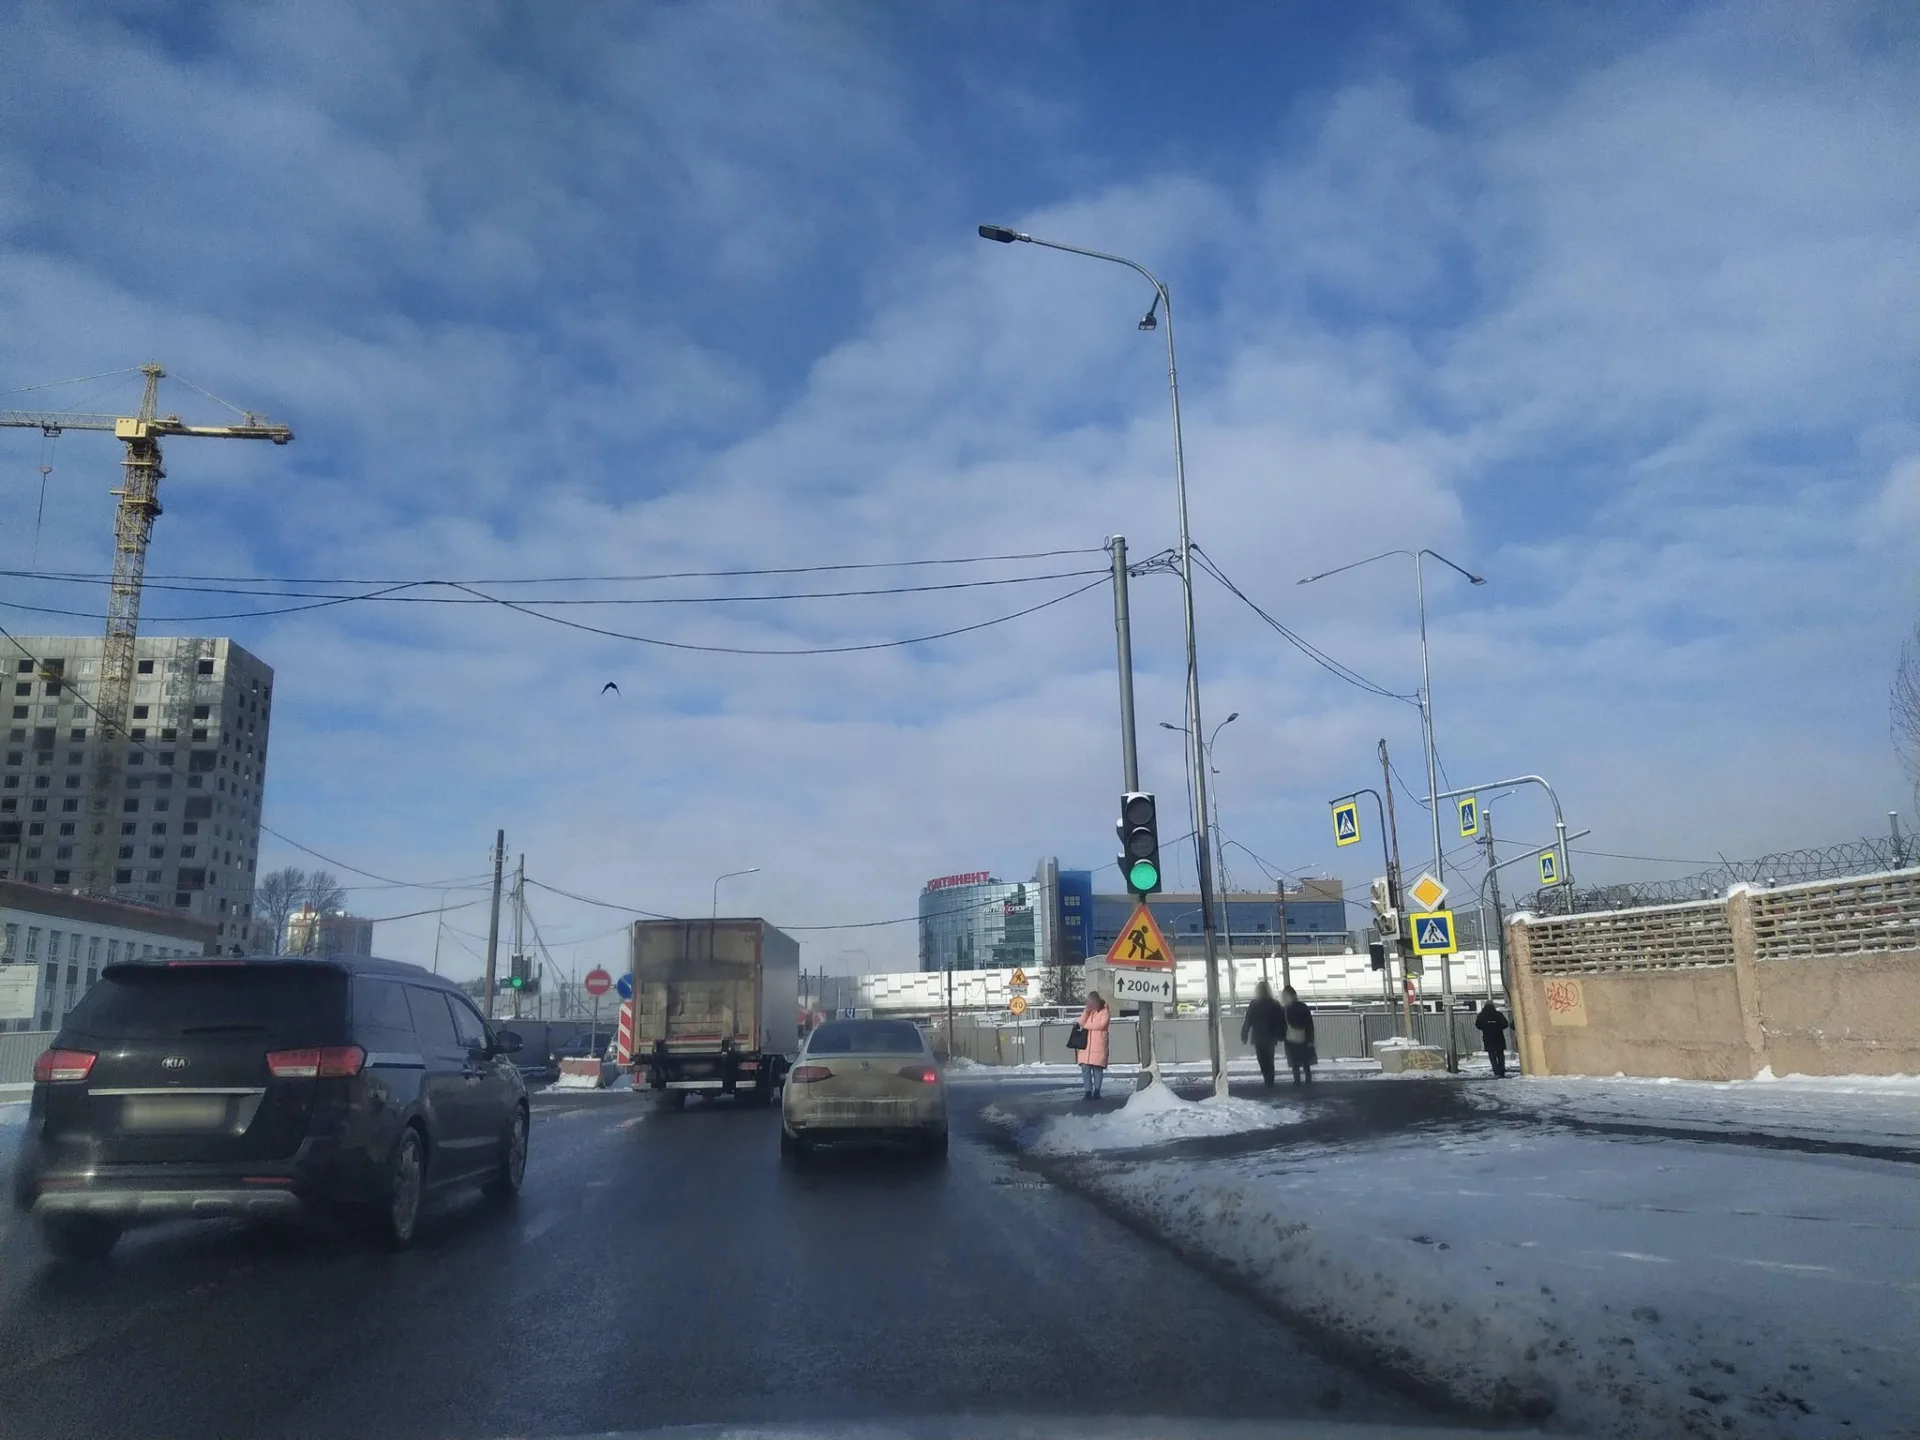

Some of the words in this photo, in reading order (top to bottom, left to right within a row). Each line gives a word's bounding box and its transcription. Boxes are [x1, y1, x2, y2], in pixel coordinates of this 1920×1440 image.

[1127, 979, 1160, 993] 200м
[1012, 1001, 1023, 1009] 40
[166, 1058, 186, 1068] KIA
